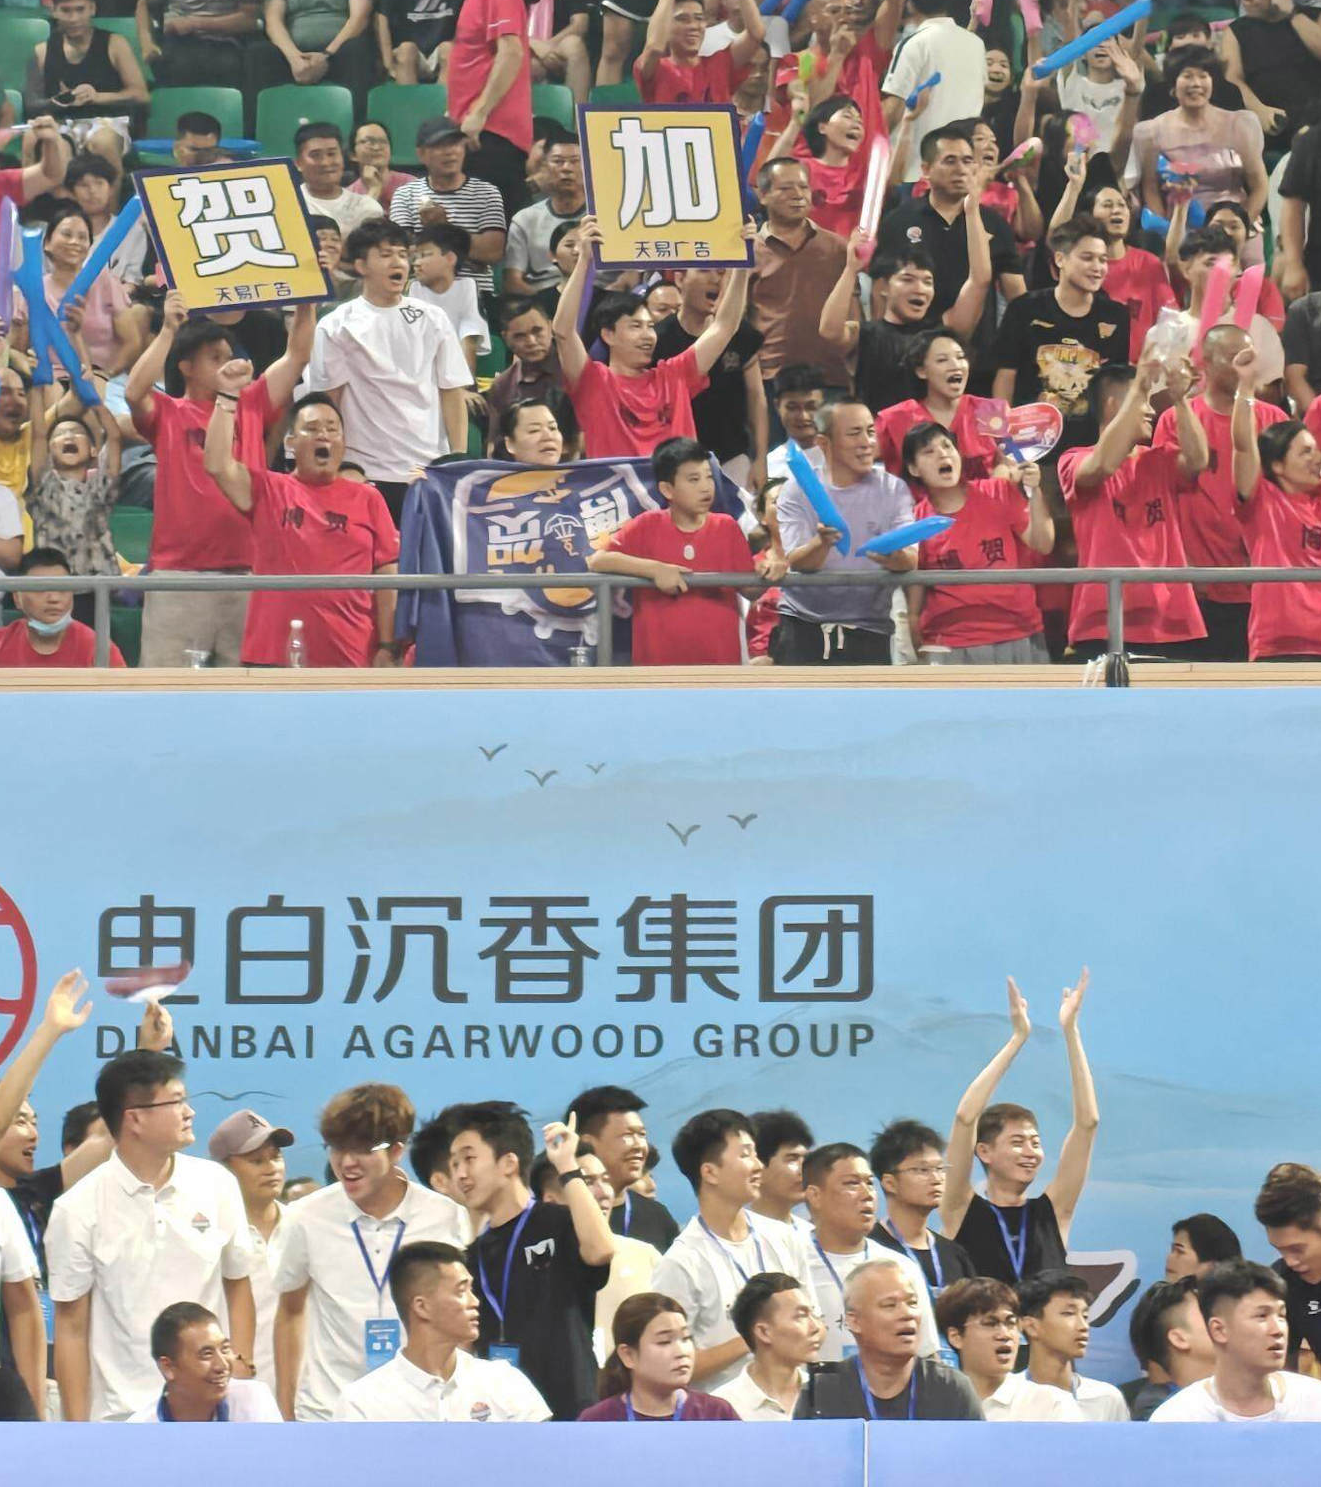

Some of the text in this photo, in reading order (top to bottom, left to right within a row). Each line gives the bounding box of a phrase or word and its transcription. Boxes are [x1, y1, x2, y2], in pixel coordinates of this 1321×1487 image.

[610, 117, 720, 231] 加
[169, 175, 300, 278] 贺
[635, 240, 710, 258] 天易广告
[215, 282, 291, 303] 天易广告
[97, 893, 876, 1005] 电白沉香集团
[343, 1024, 663, 1059] AGARWOOD
[692, 1022, 874, 1059] GROUP
